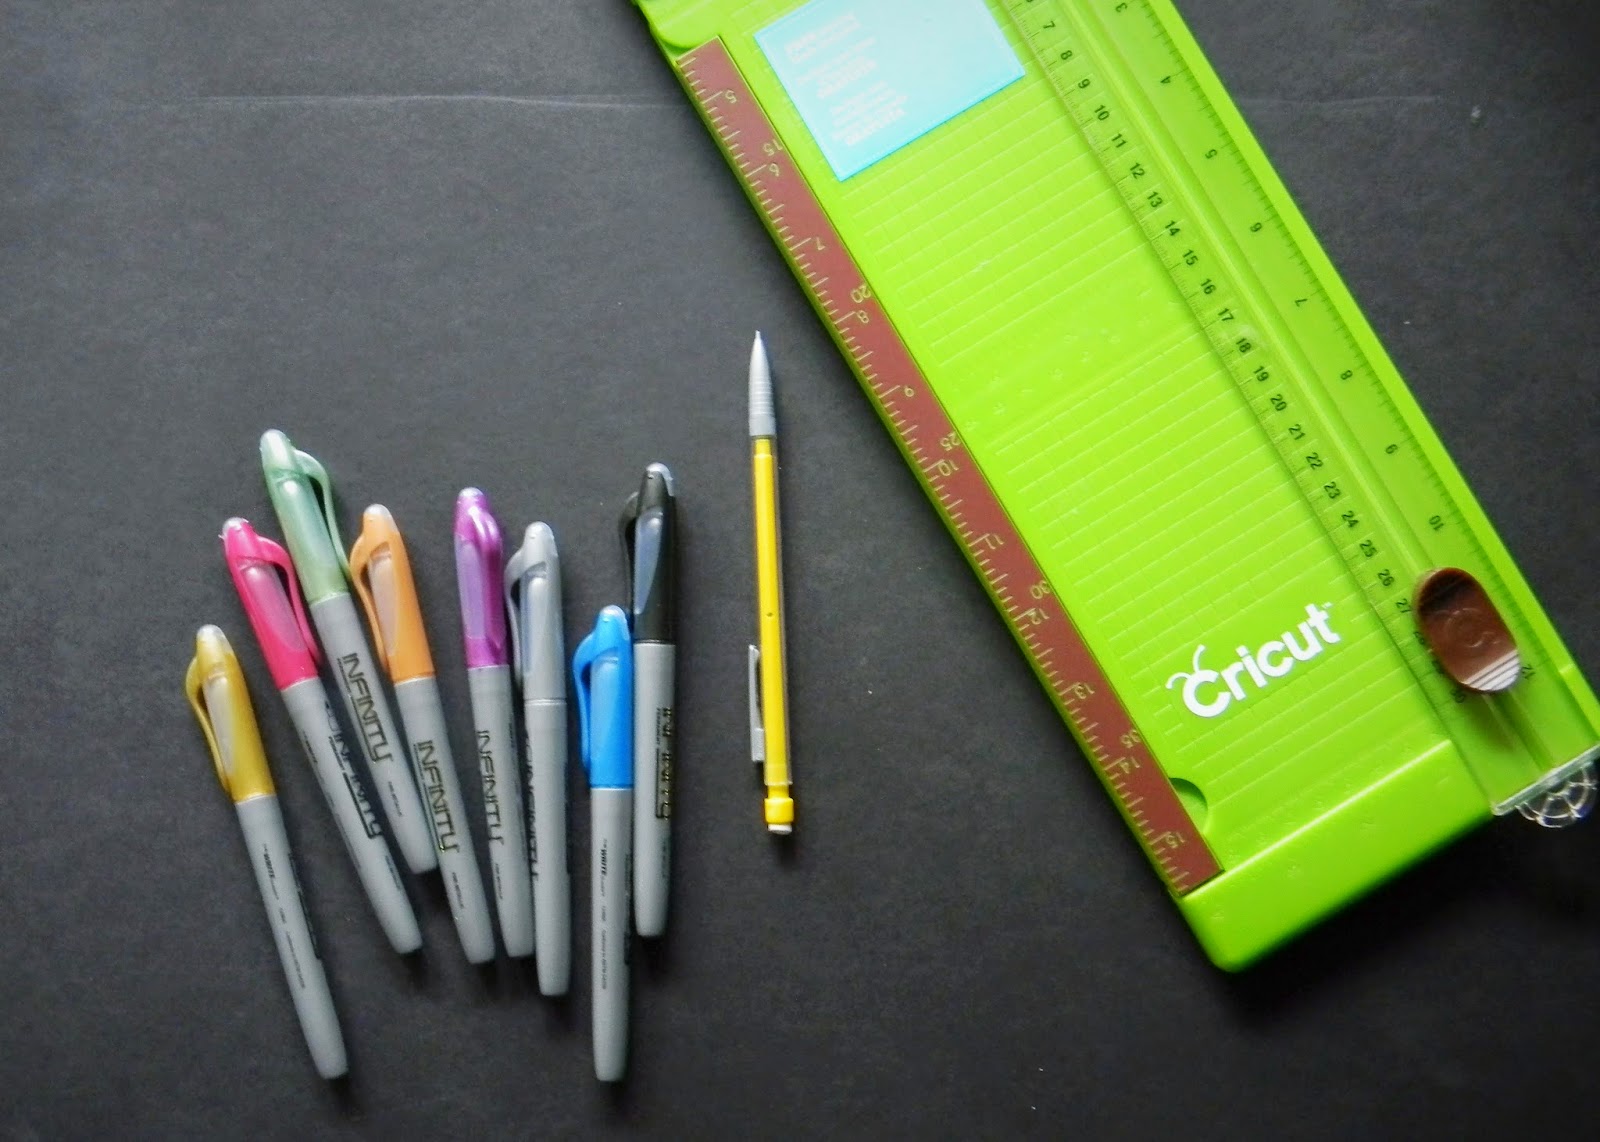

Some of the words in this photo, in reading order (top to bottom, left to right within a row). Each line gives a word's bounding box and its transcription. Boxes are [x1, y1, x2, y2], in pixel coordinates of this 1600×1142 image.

[725, 90, 737, 103] 5
[768, 163, 780, 177] 6
[815, 237, 826, 250] 7
[857, 310, 869, 324] 8
[904, 385, 915, 398] 9
[937, 460, 960, 476] 10
[1073, 682, 1096, 700] 13
[1118, 756, 1141, 774] 14
[1164, 830, 1186, 849] 15
[763, 140, 783, 156] 15
[851, 285, 872, 303] 20
[941, 432, 962, 451] 25
[1029, 579, 1050, 599] 30
[1120, 729, 1141, 748] 35
[1043, 21, 1056, 31] 7
[1060, 50, 1073, 61] 8
[1078, 77, 1091, 90] 9
[1094, 104, 1109, 121] 10
[1111, 133, 1127, 148] 11
[1130, 162, 1145, 179] 12
[1147, 191, 1163, 208] 13
[1165, 220, 1180, 236] 14
[1182, 249, 1198, 266] 15
[1200, 278, 1216, 295] 16
[1218, 307, 1234, 322] 17
[1236, 337, 1252, 353] 18
[1253, 366, 1270, 382] 19
[1270, 394, 1287, 411] 20
[1289, 424, 1305, 440] 21
[1306, 452, 1323, 470] 22
[1324, 481, 1341, 499] 23
[1341, 510, 1359, 528] 24
[1359, 540, 1377, 558] 25
[1377, 569, 1395, 587] 26
[1395, 598, 1411, 613] 27
[1115, 2, 1128, 13] 3
[1160, 76, 1171, 85] 4
[1205, 149, 1218, 160] 5
[1250, 221, 1263, 233] 6
[1295, 297, 1308, 307] 7
[1340, 369, 1353, 381] 8
[1385, 443, 1398, 455] 9
[1428, 514, 1445, 532] 10
[342, 652, 393, 762] INFINITY
[417, 740, 459, 853] INFINITY
[1166, 602, 1341, 718] Cricut
